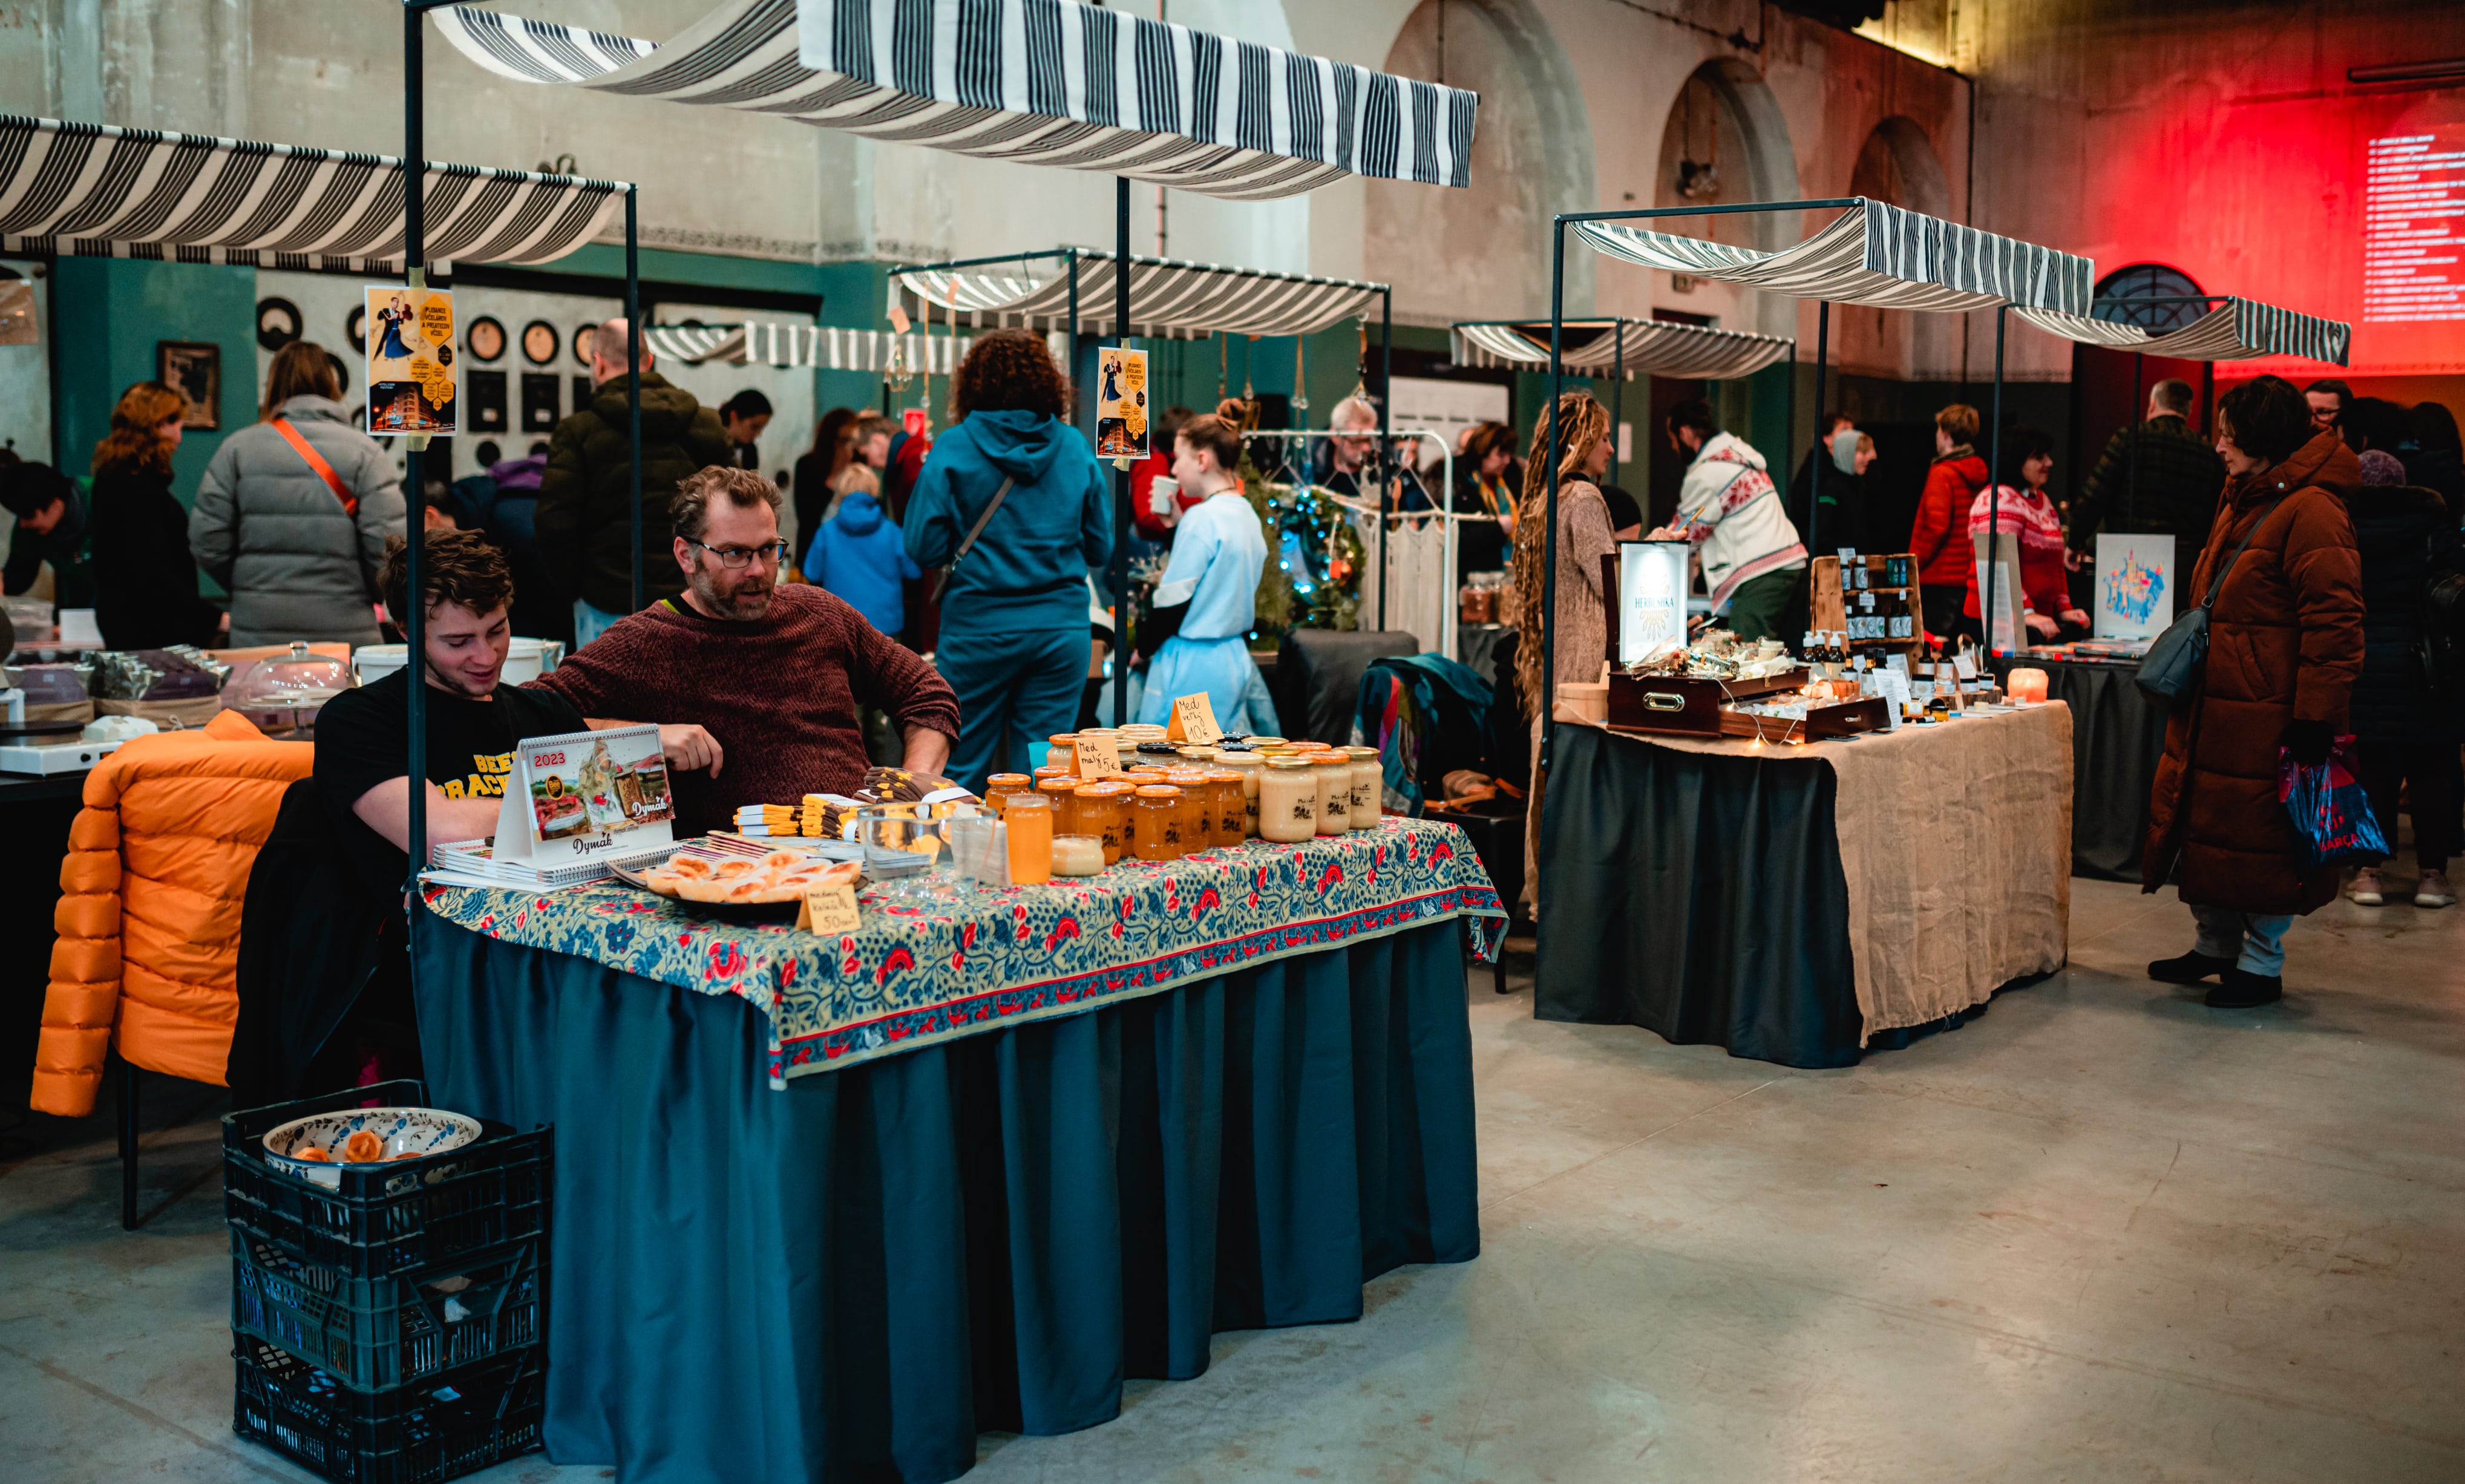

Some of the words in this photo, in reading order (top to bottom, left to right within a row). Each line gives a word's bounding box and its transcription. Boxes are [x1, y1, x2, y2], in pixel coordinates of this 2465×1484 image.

[1179, 697, 1200, 711] Med
[1079, 742, 1098, 753] Med
[473, 751, 517, 773] BEE
[534, 752, 566, 768] 2023
[1081, 753, 1102, 770] malý
[2319, 833, 2359, 852] BARÇA
